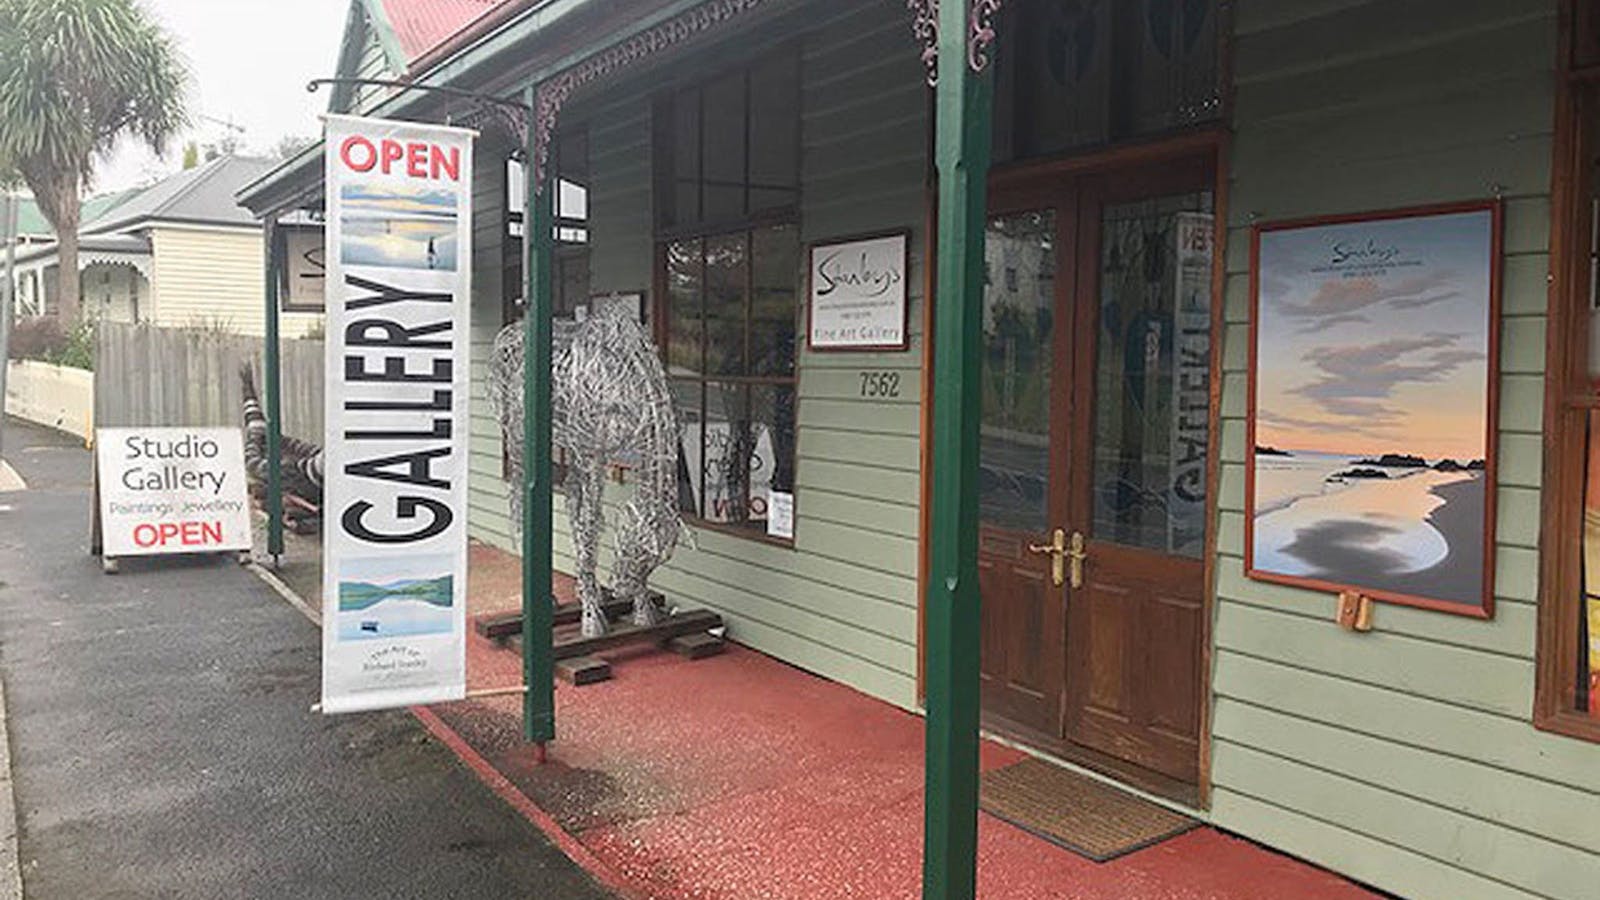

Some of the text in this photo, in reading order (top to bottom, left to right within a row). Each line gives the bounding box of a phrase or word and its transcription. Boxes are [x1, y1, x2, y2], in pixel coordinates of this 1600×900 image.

[339, 134, 460, 181] OPEN
[859, 372, 900, 398] 7562
[341, 274, 453, 544] GALLERY
[125, 434, 219, 459] Studio
[122, 466, 226, 495] Gallery
[109, 502, 174, 516] Paintings
[133, 521, 223, 548] OPEN
